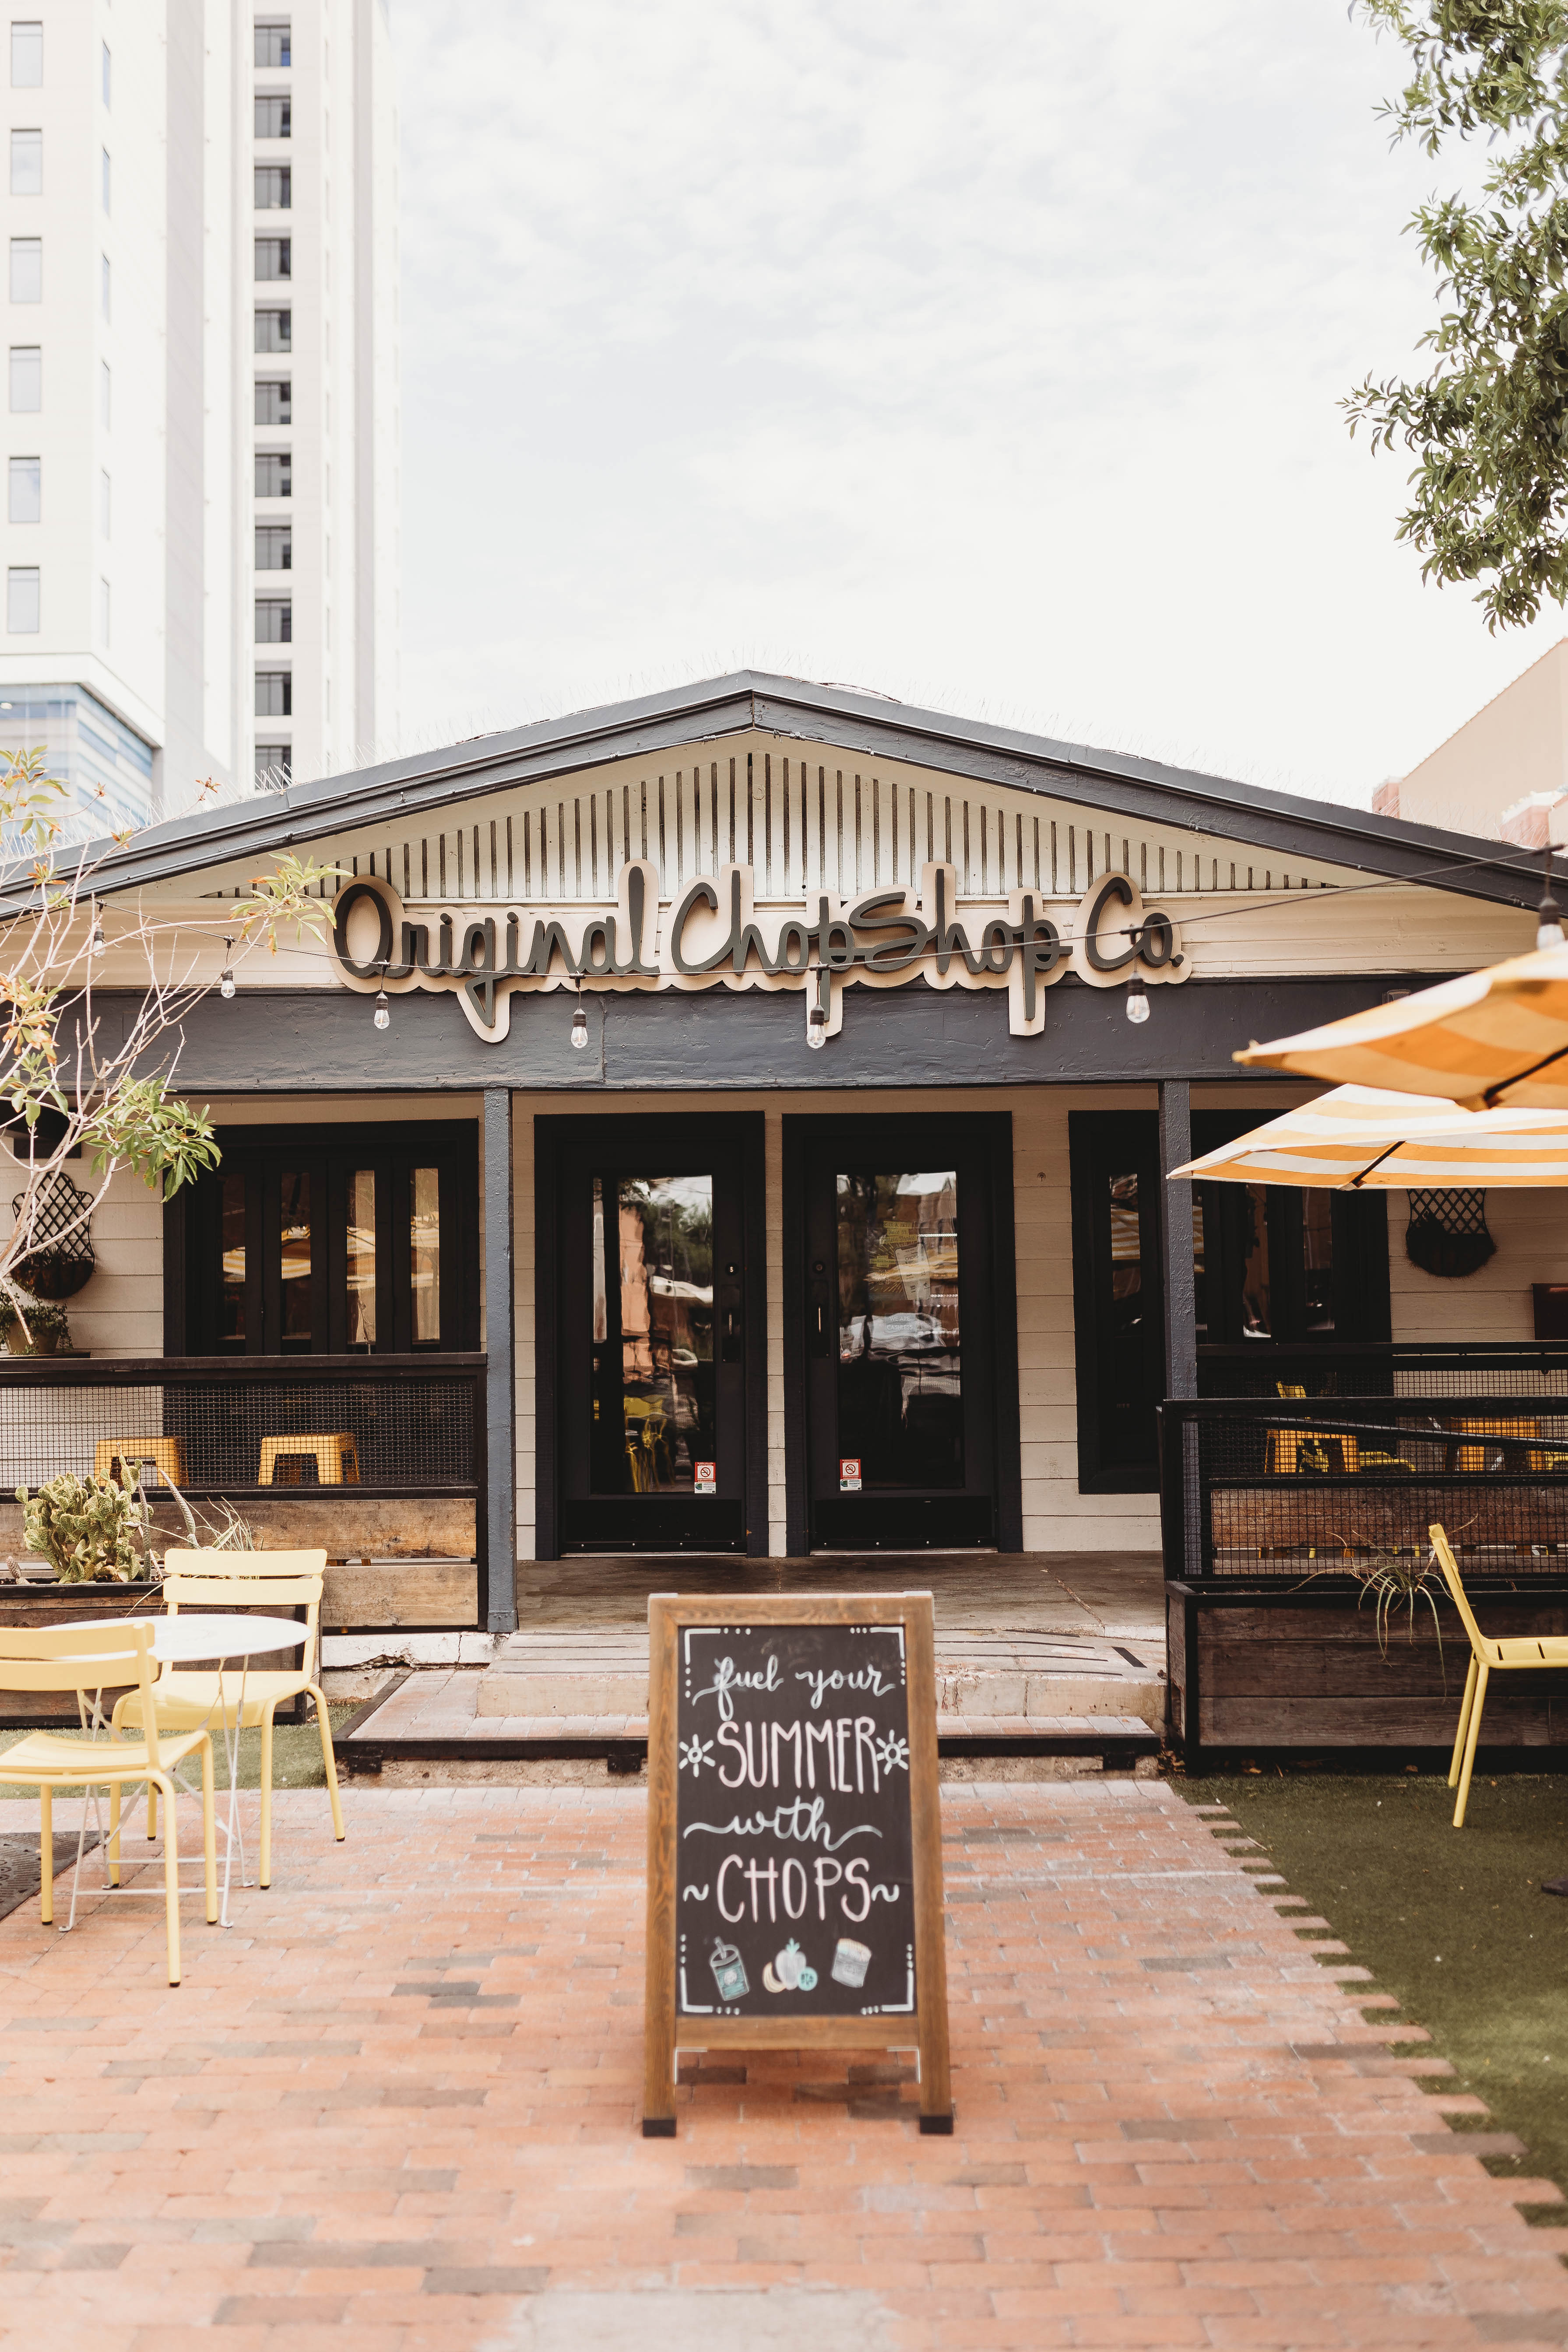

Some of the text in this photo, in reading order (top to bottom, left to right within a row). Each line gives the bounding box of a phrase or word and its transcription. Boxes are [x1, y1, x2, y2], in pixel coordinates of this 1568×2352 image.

[333, 866, 660, 1028] Original
[1085, 876, 1184, 972] Co.
[692, 1654, 896, 1721] fuel your
[717, 1716, 881, 1793] SUMMER
[683, 1795, 882, 1851] with
[717, 1853, 872, 1923] CHOPS
